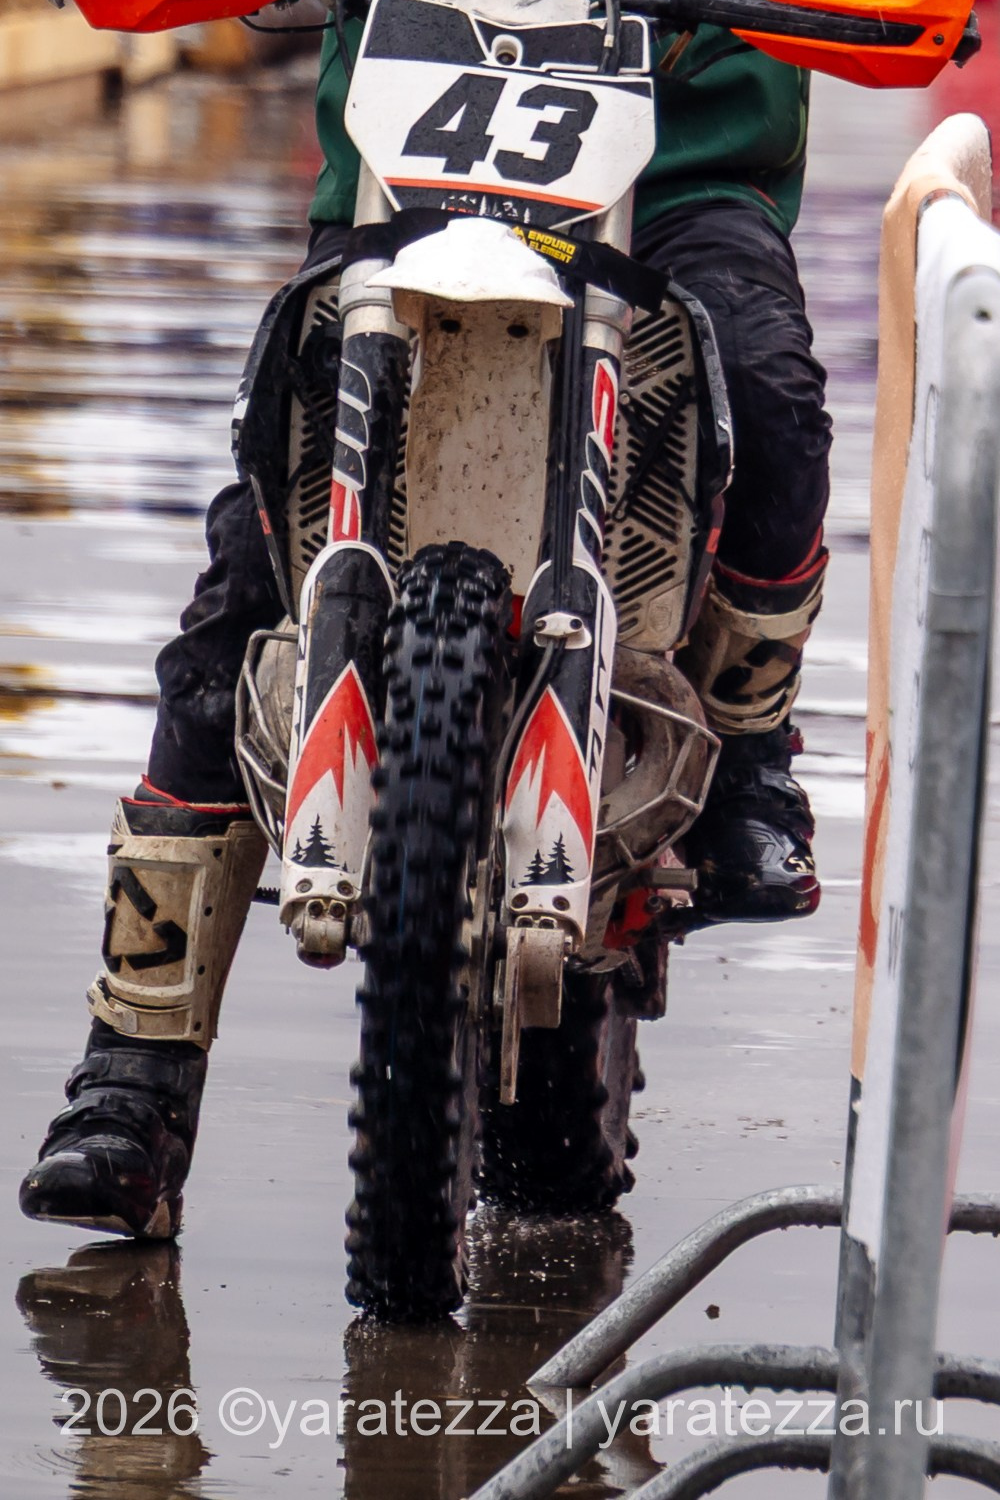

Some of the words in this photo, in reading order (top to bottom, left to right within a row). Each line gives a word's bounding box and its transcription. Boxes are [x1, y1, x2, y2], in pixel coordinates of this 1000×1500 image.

[400, 72, 599, 186] 43
[528, 230, 576, 255] ENDURO
[529, 241, 573, 264] ELEMENT
